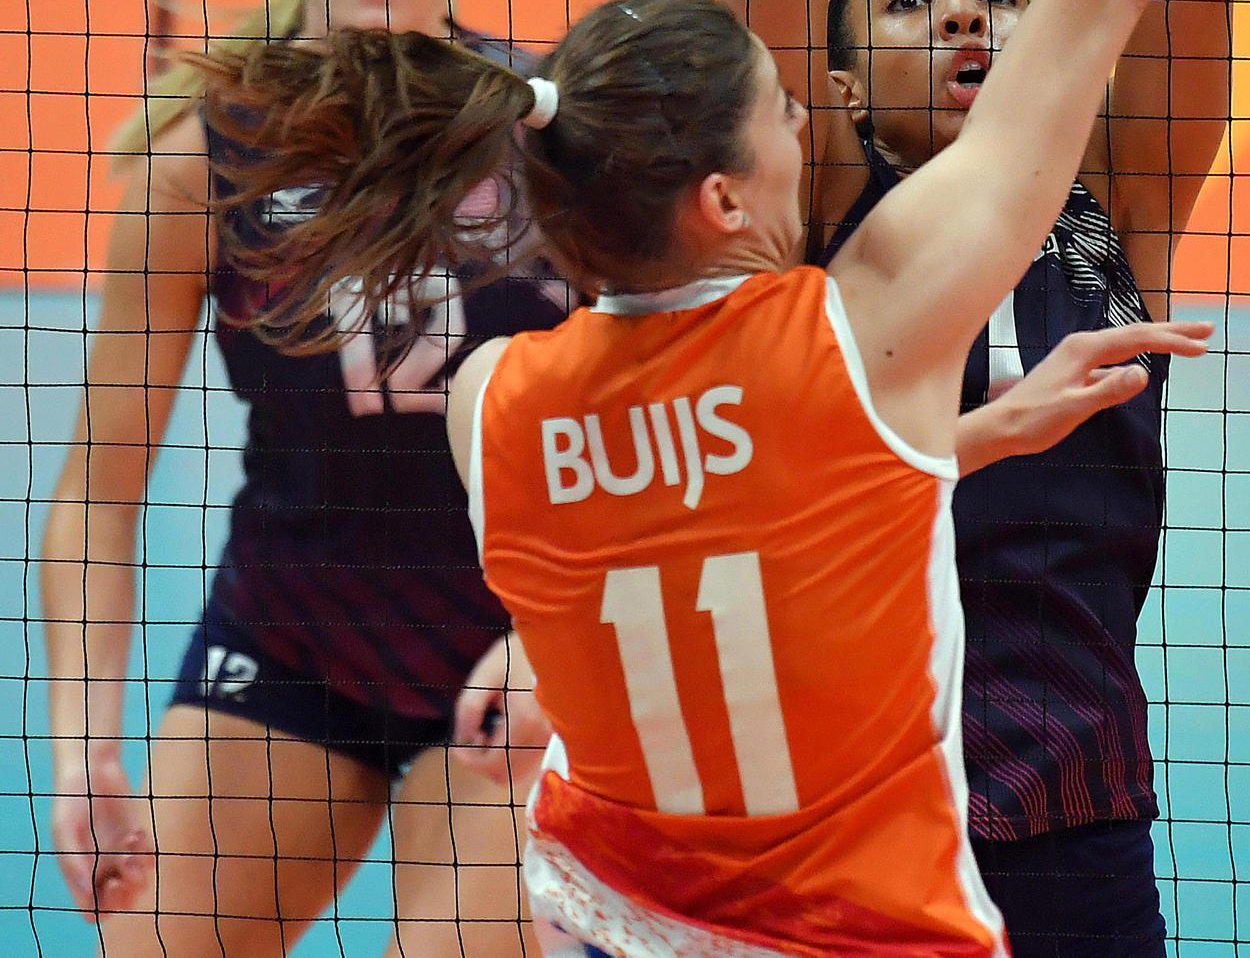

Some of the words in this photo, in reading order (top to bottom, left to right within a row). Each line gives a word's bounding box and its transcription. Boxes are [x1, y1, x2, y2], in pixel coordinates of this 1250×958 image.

[541, 385, 754, 509] BUIJS
[200, 645, 259, 697] 12
[600, 551, 799, 817] 11
